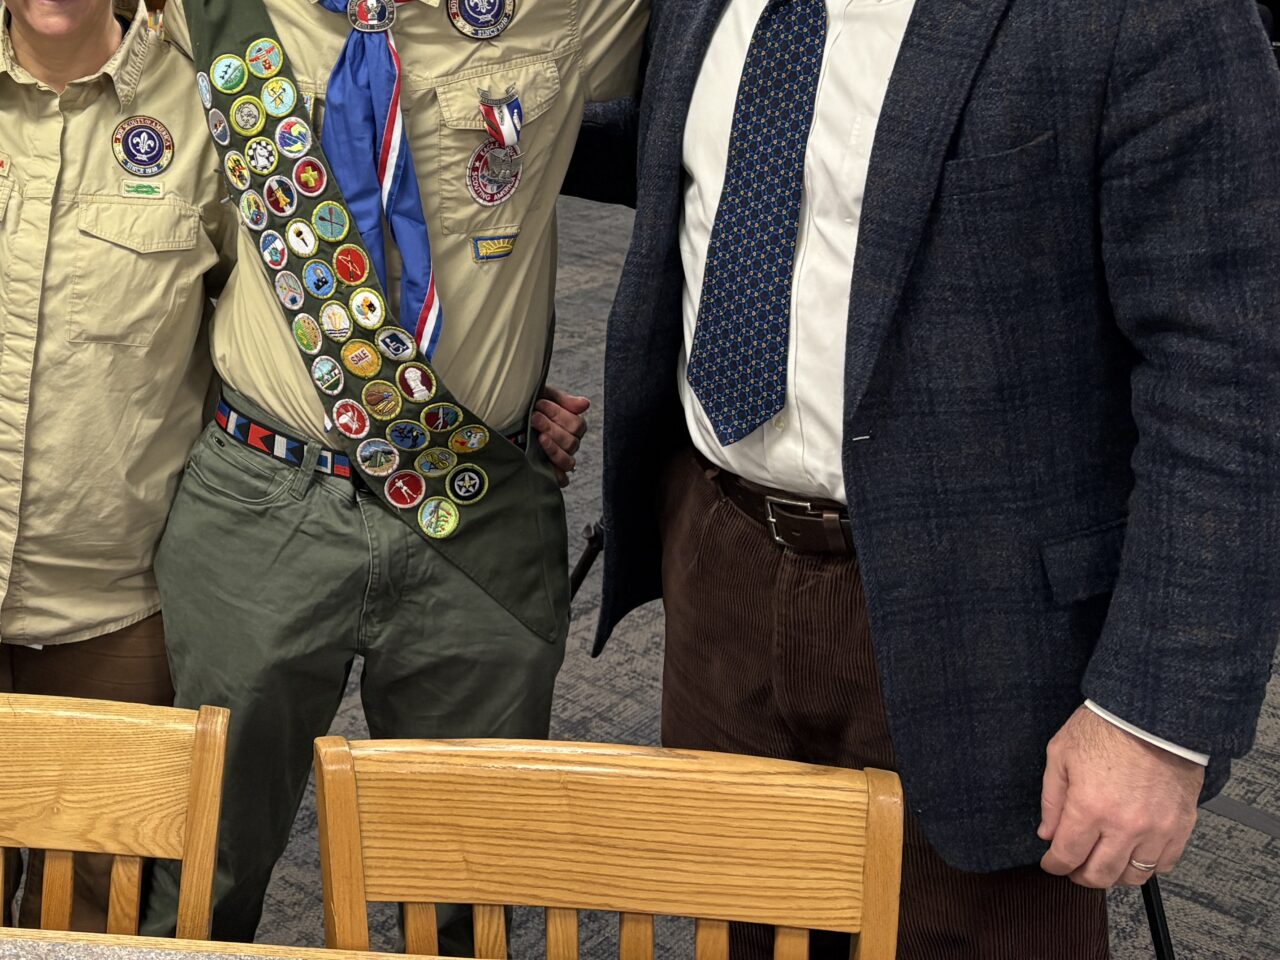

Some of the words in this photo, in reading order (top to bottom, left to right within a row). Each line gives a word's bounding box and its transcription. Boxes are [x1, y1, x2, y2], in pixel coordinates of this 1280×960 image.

[478, 27, 498, 37] SINCE
[472, 171, 492, 201] SCOUTING
[494, 177, 516, 201] AMERICA
[351, 349, 369, 365] SALE
